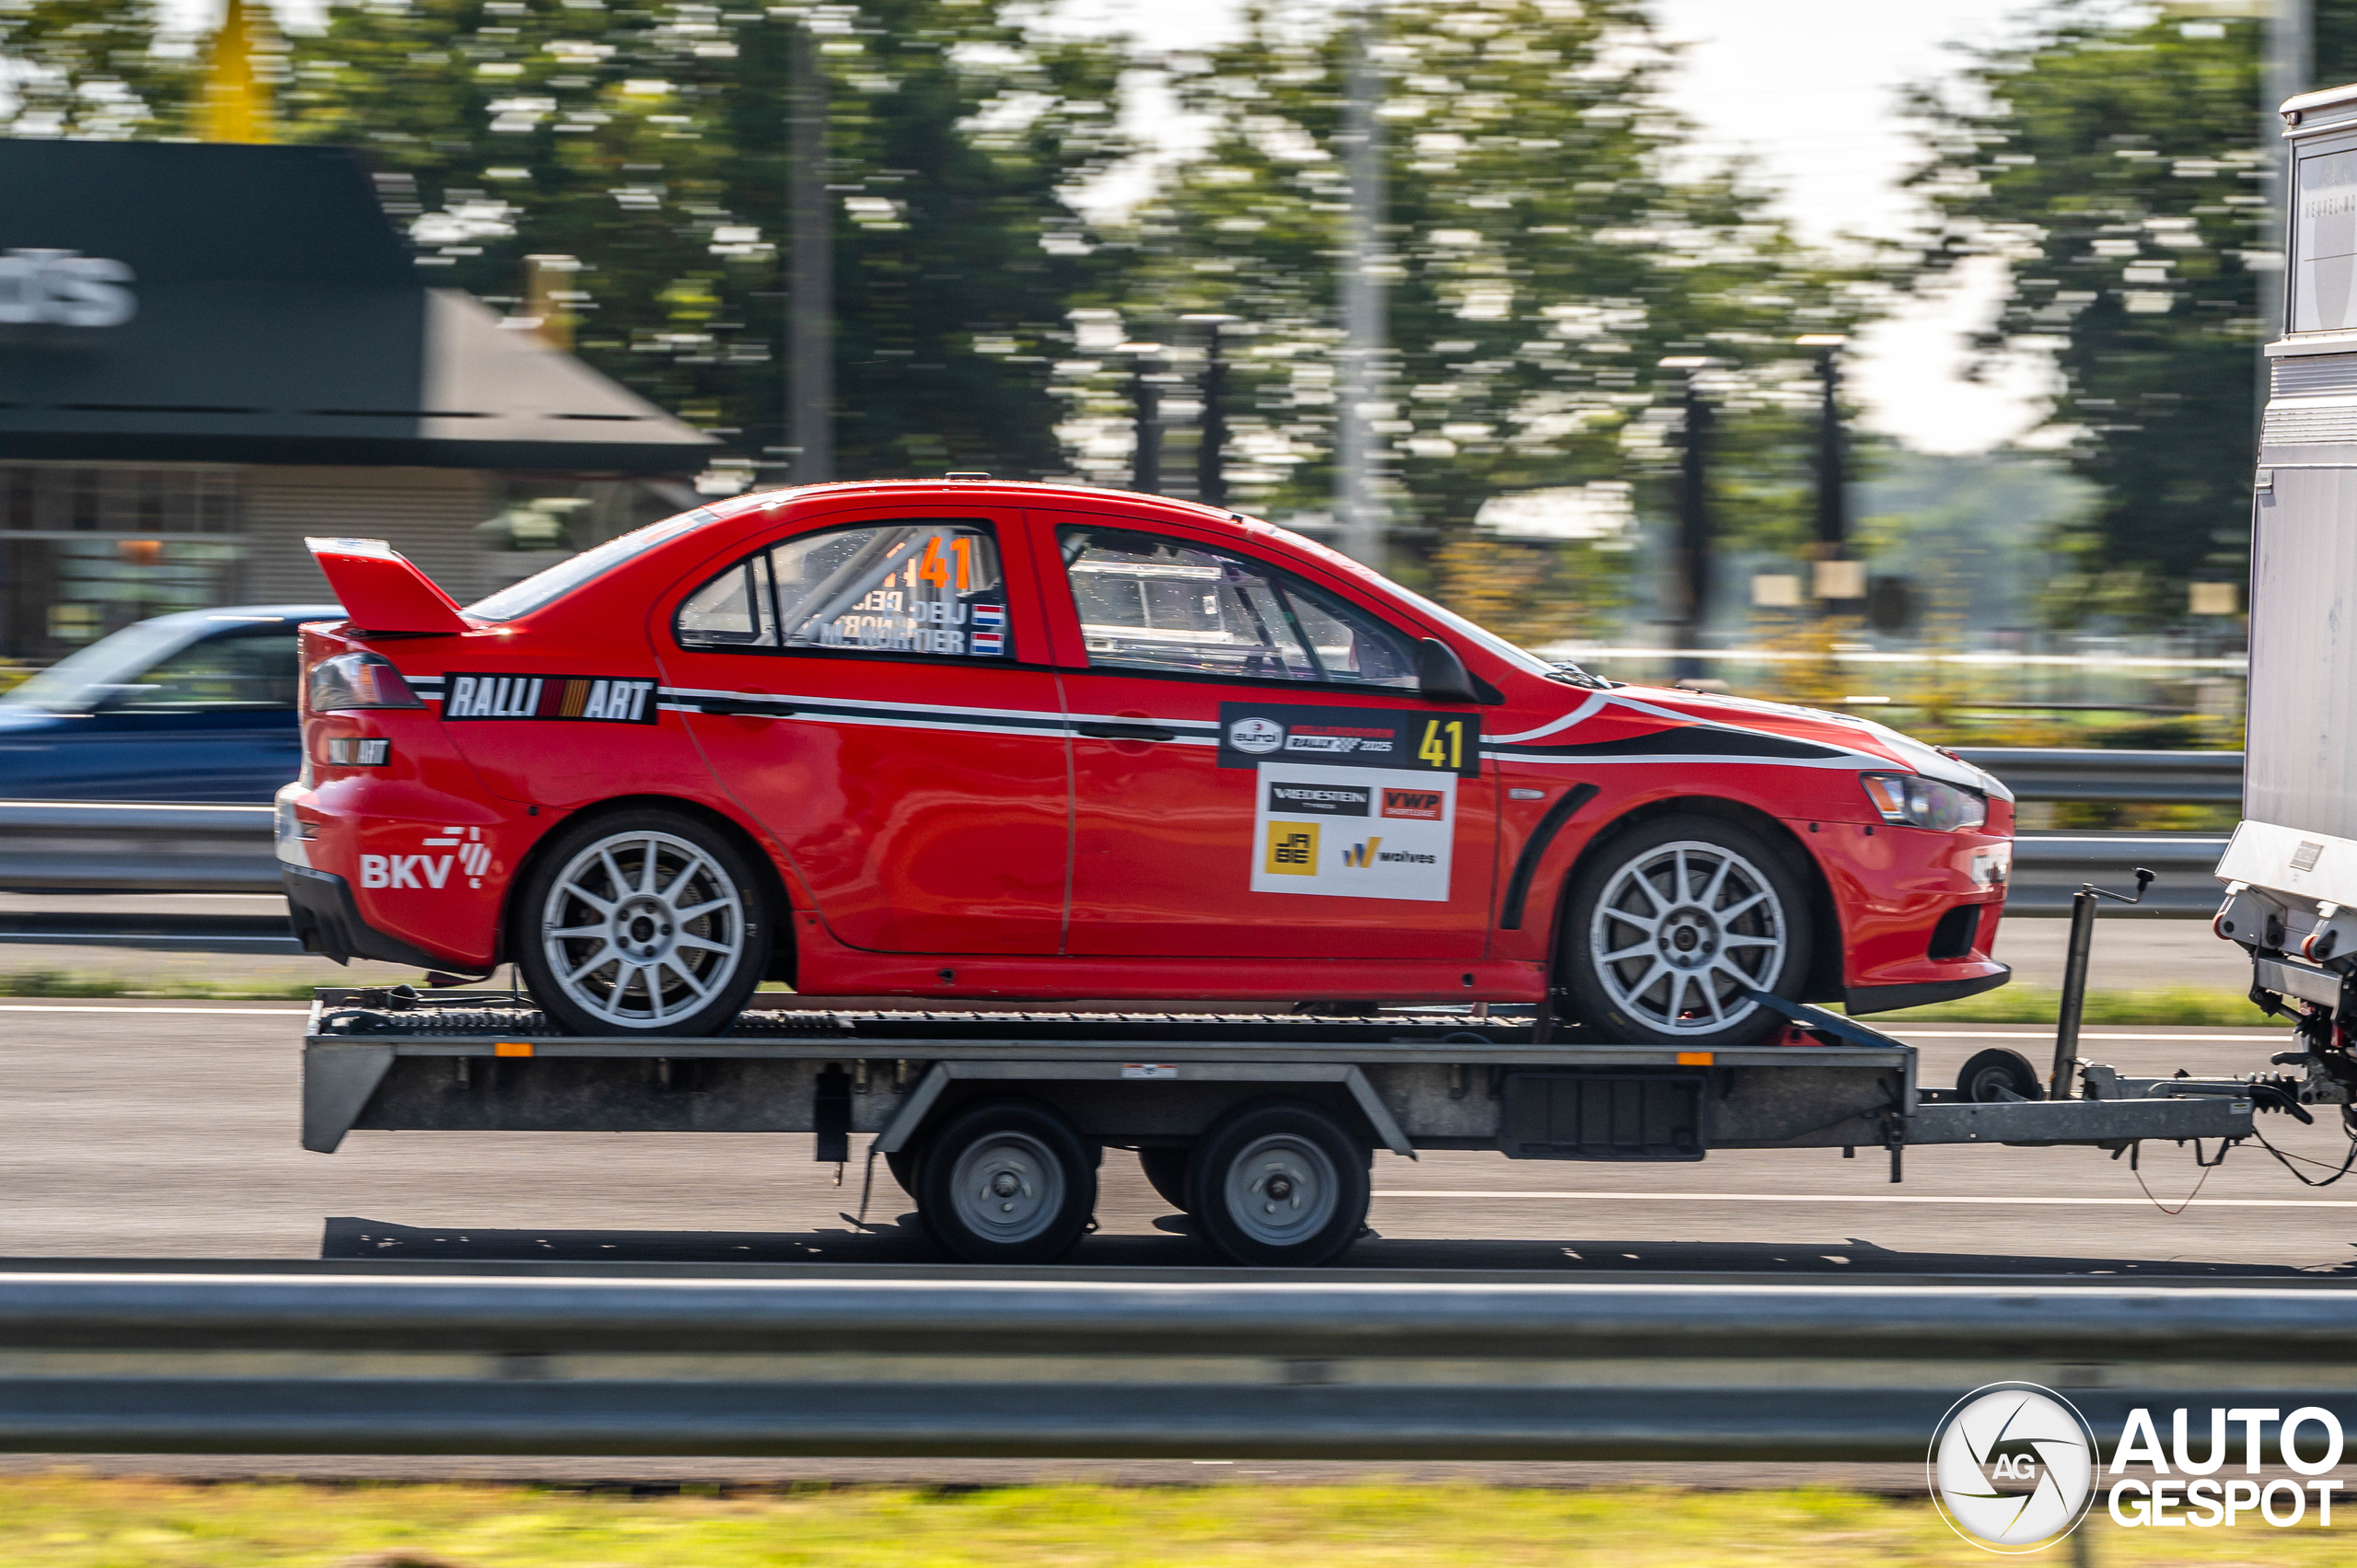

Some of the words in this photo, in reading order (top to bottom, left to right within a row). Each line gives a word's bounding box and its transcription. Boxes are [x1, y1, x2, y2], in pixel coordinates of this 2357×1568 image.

[919, 536, 970, 589] 41
[583, 679, 654, 721] ART
[1418, 719, 1464, 769] 41
[1385, 791, 1440, 809] VWP
[359, 854, 455, 890] BKV
[1378, 850, 1437, 865] wolves
